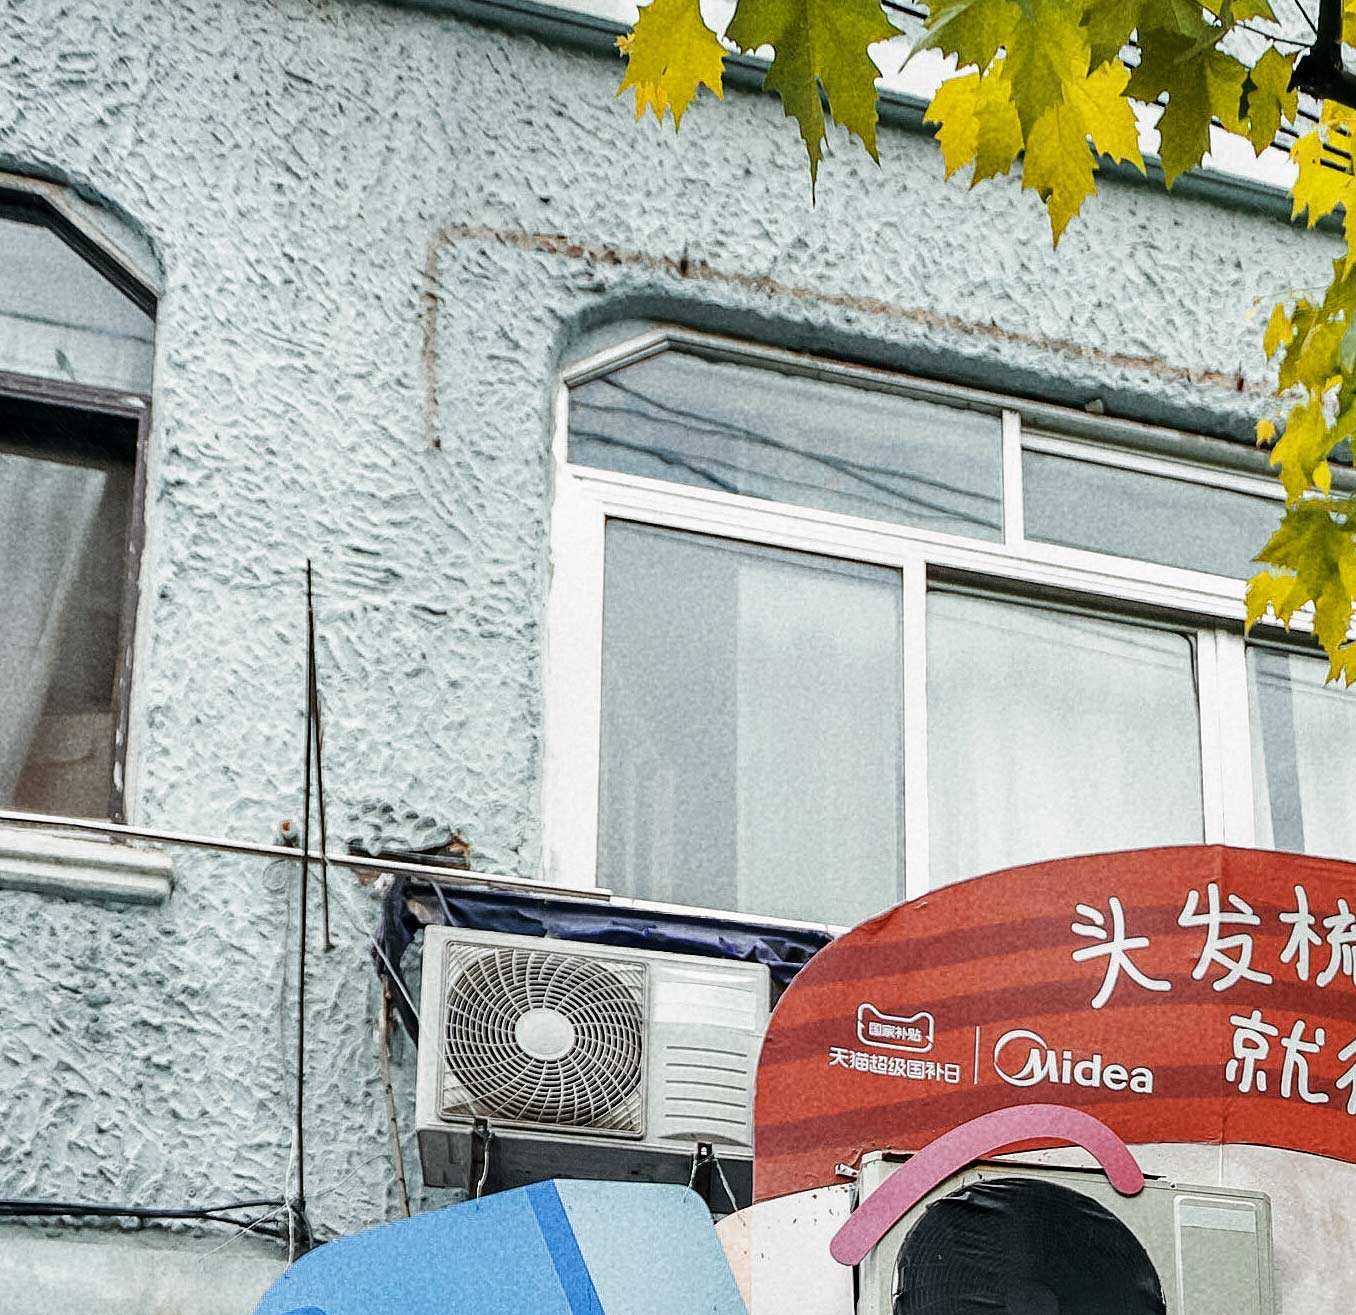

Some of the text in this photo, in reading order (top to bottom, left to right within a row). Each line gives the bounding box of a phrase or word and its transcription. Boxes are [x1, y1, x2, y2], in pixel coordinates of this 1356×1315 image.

[829, 1046, 961, 1084] 天猫超级国补日
[994, 1029, 1154, 1094] Midea
